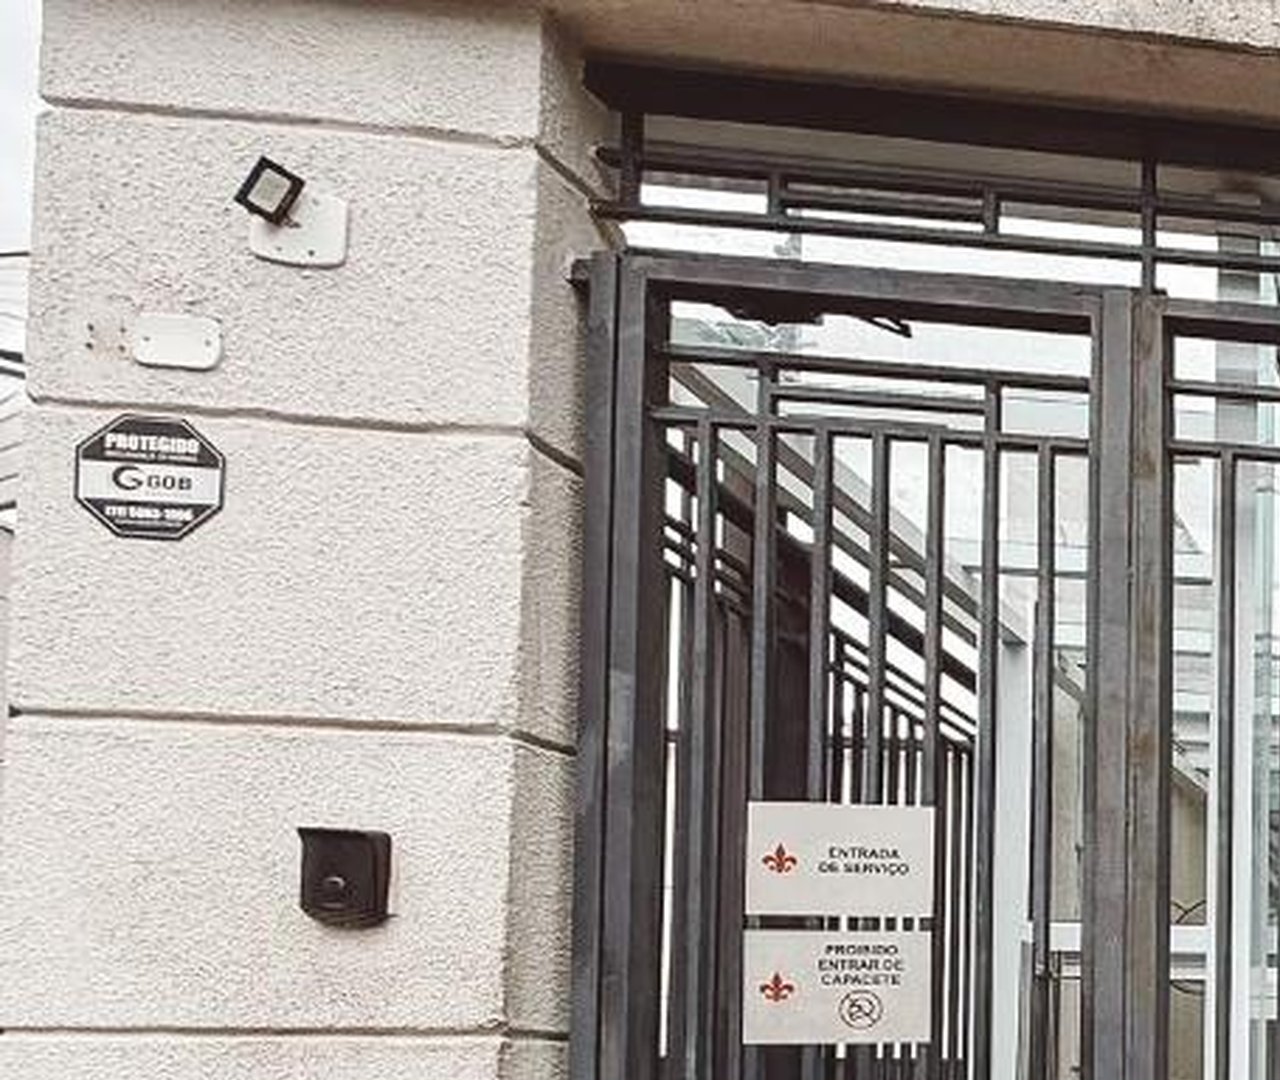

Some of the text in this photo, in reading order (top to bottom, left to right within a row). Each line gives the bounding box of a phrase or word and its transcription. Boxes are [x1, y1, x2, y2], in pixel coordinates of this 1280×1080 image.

[104, 432, 199, 454] PROTEGIDO
[828, 846, 901, 860] ENTRADA
[817, 861, 910, 876] DE SERVIÇO
[824, 944, 899, 955] PROIBIDO
[817, 959, 880, 971] ENTRAR
[820, 974, 902, 986] CAPACETE
